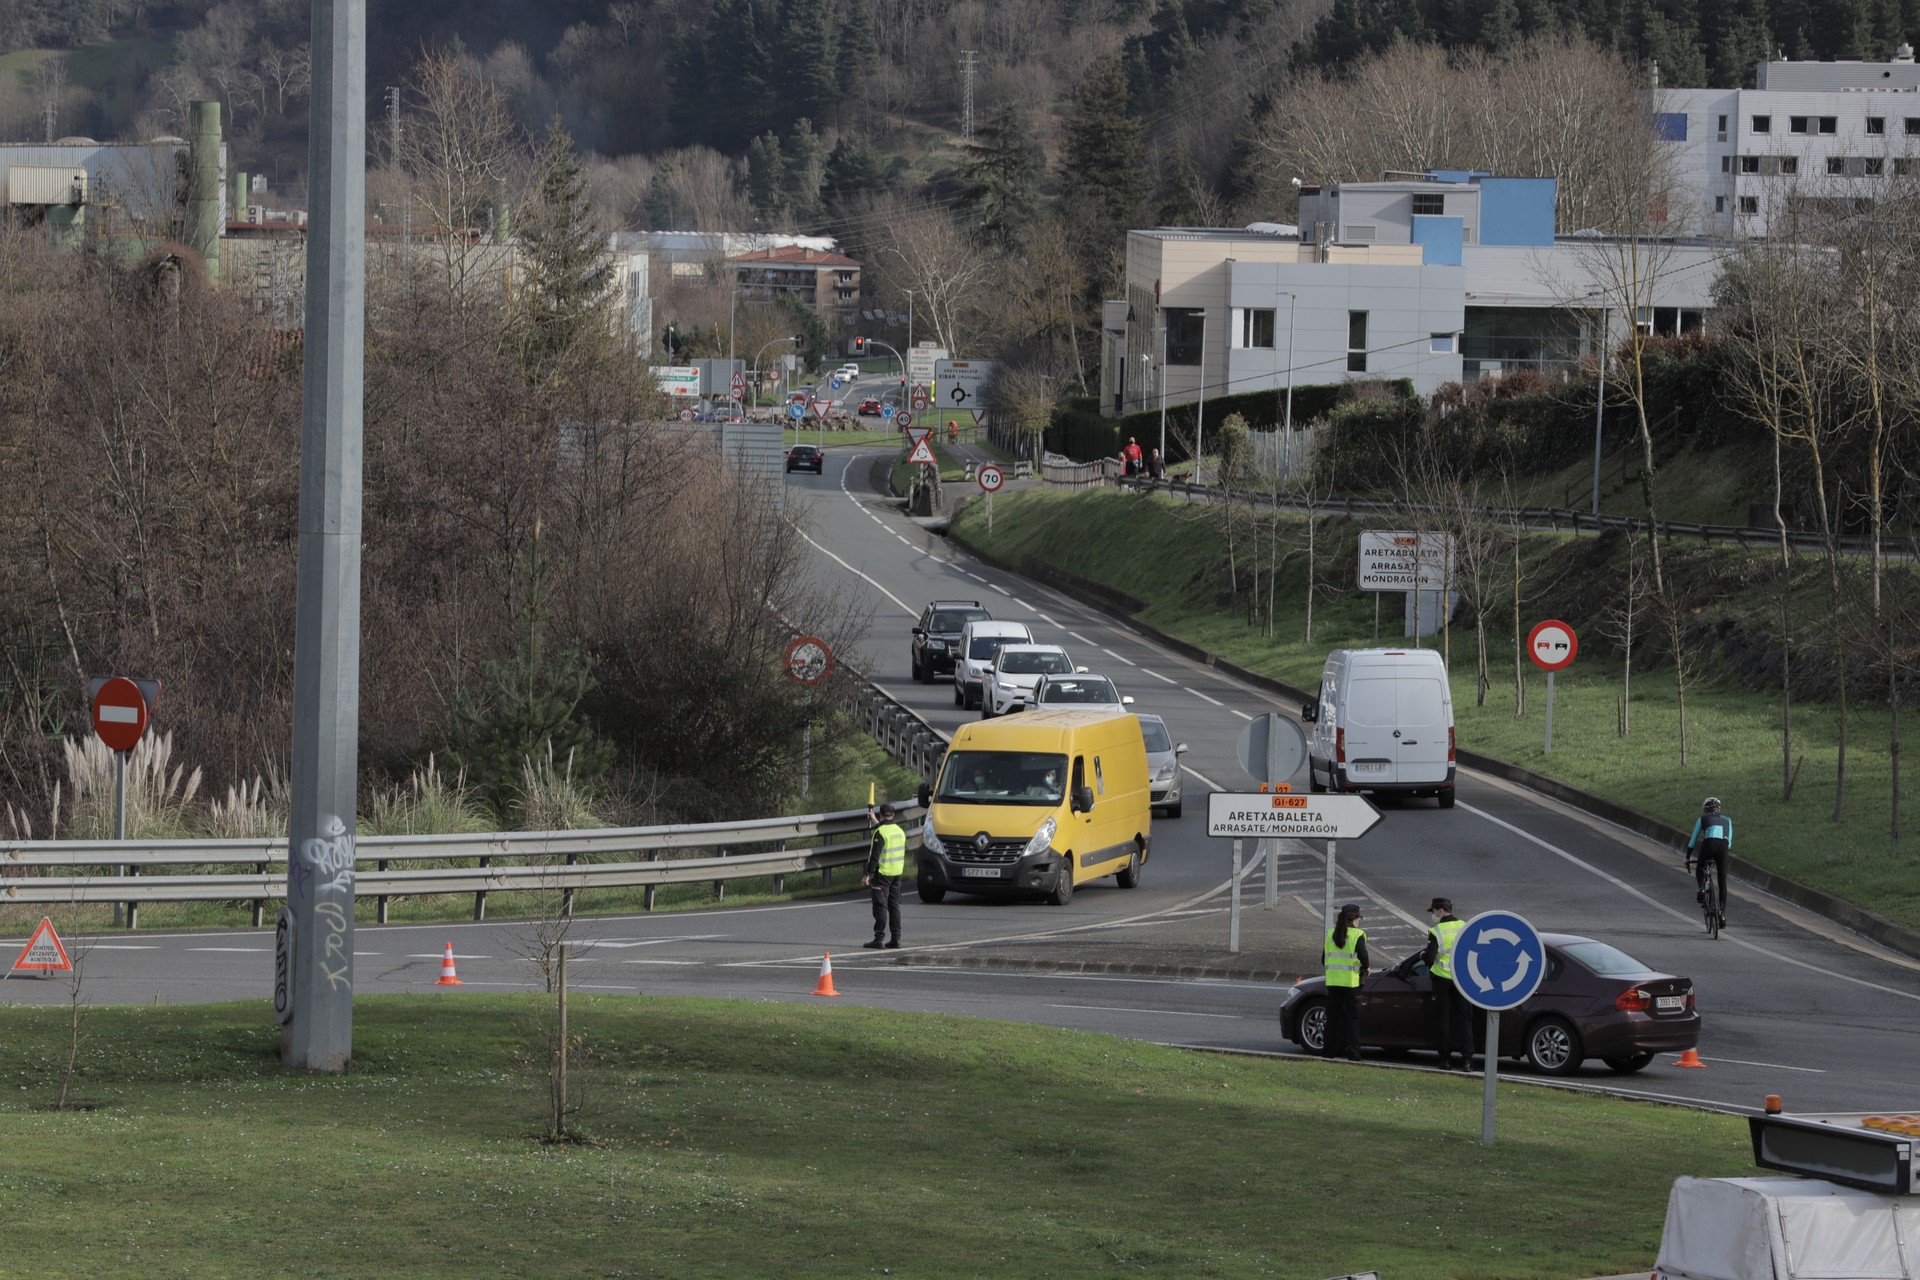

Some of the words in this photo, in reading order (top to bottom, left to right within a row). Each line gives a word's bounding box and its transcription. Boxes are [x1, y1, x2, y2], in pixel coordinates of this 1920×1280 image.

[984, 474, 999, 483] 70
[1365, 549, 1439, 557] ARETXABAETA
[1274, 798, 1305, 807] GI-627
[1229, 812, 1323, 821] ARETXABALETA
[1213, 823, 1338, 833] ARRASATE/MONDRAGÓN
